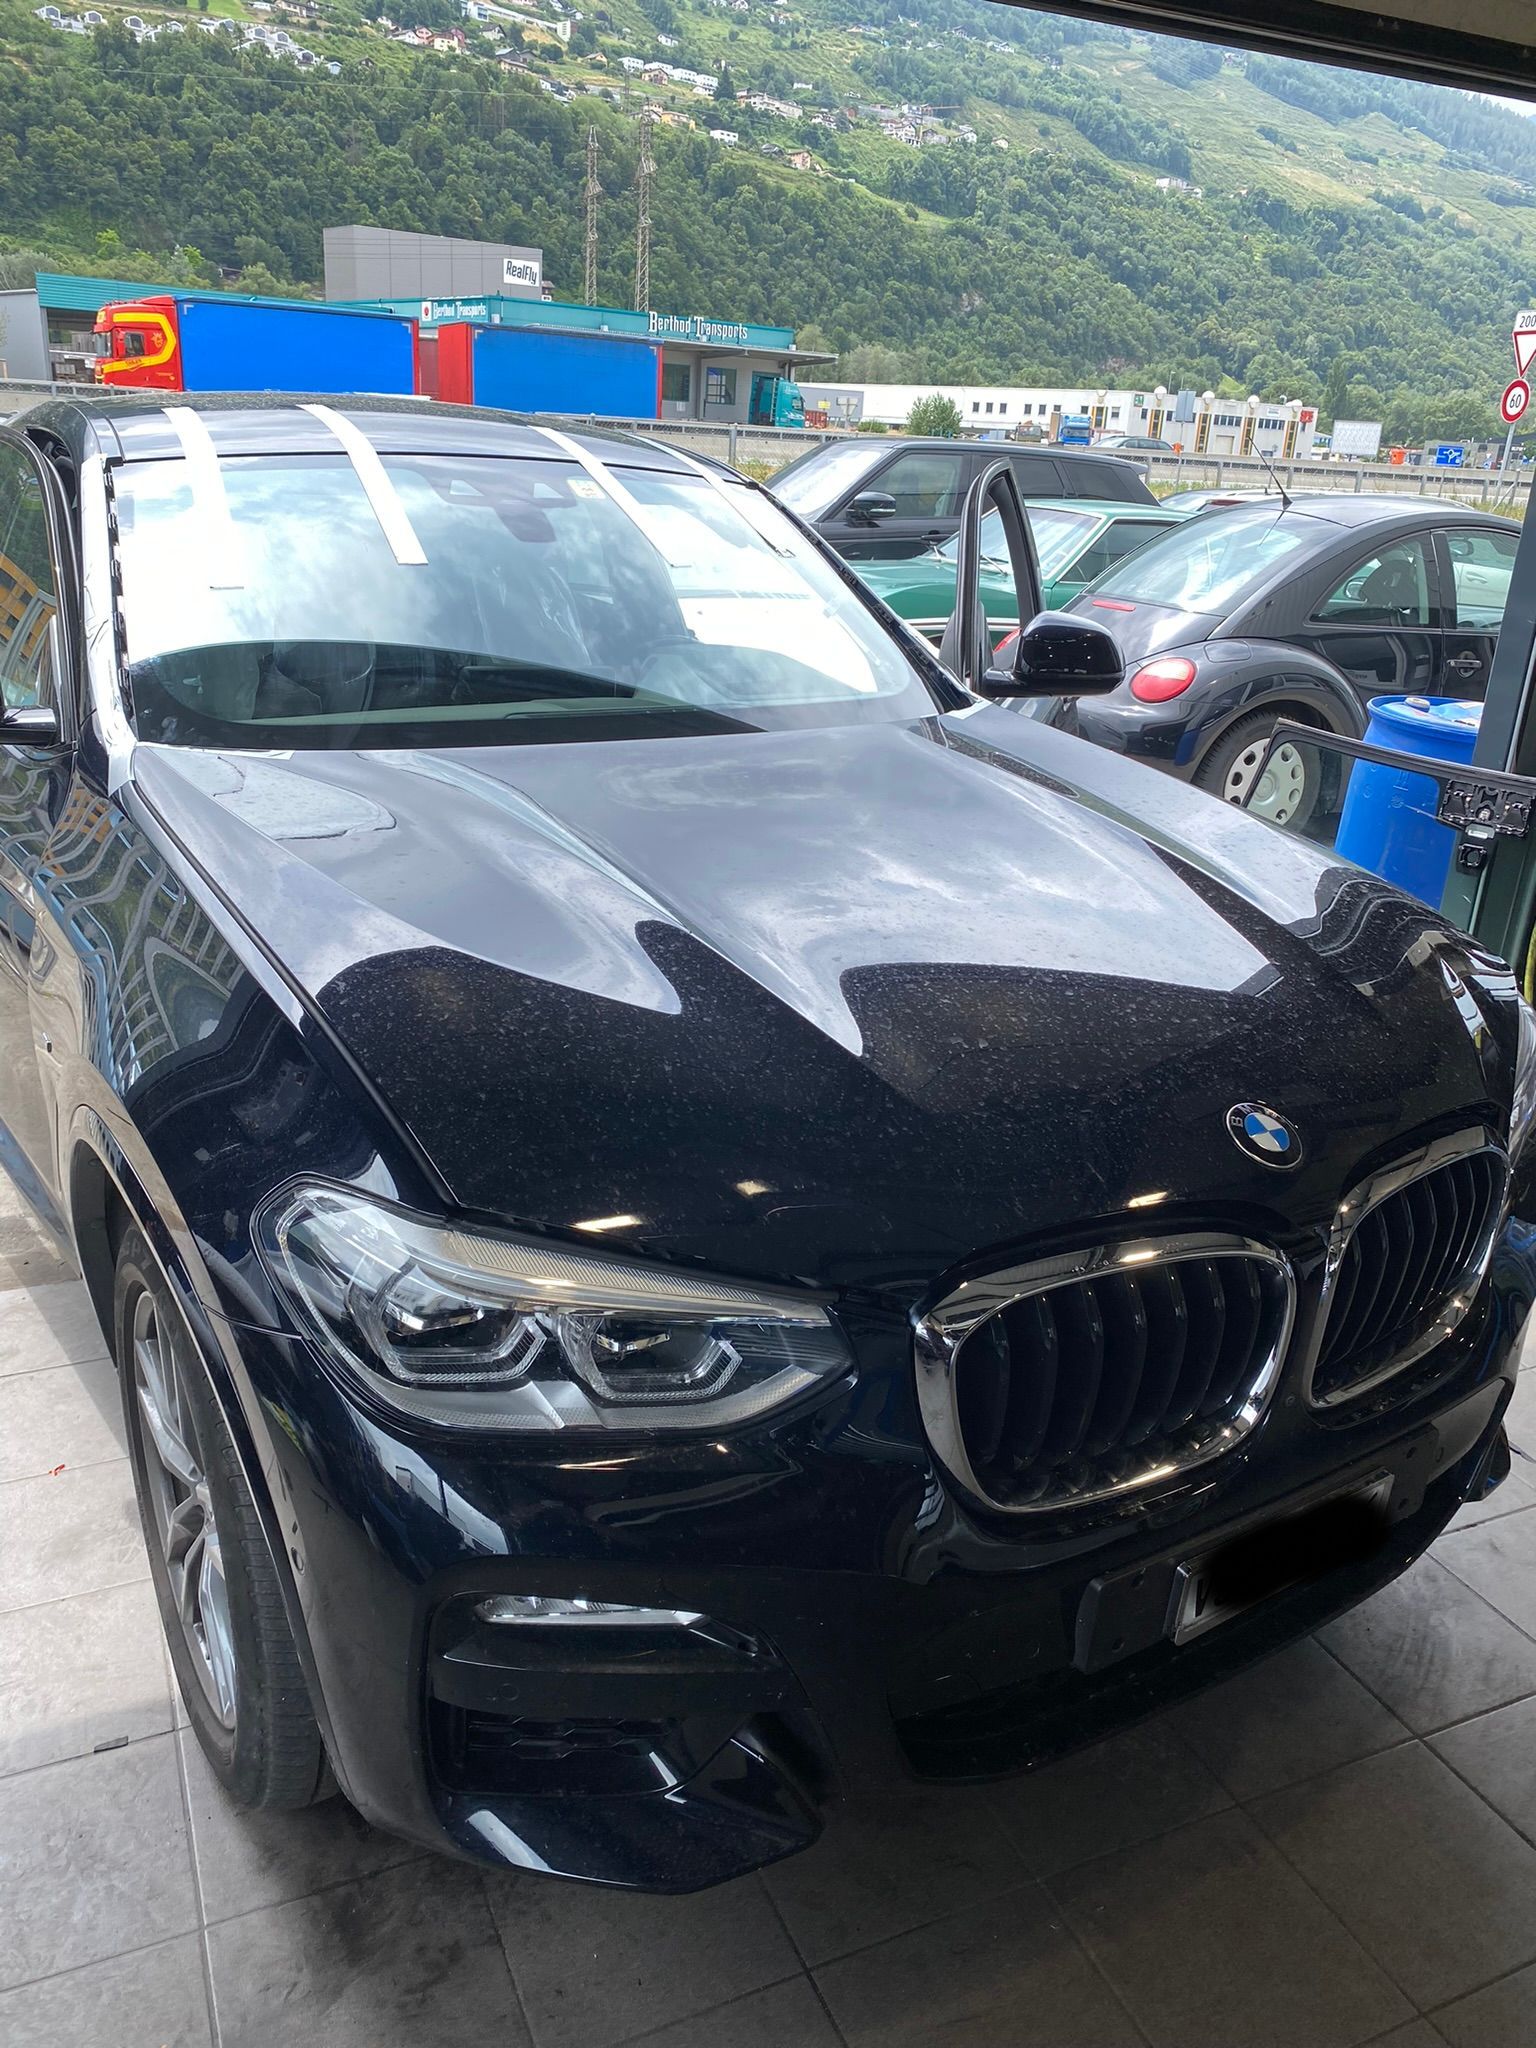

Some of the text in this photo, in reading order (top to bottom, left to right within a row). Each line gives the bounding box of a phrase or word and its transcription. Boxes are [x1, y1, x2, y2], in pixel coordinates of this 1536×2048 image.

[506, 260, 538, 285] RealFly
[456, 302, 487, 319] Transports
[648, 311, 749, 340] Berthod Transports
[1520, 315, 1536, 328] 200
[1509, 394, 1522, 408] 60
